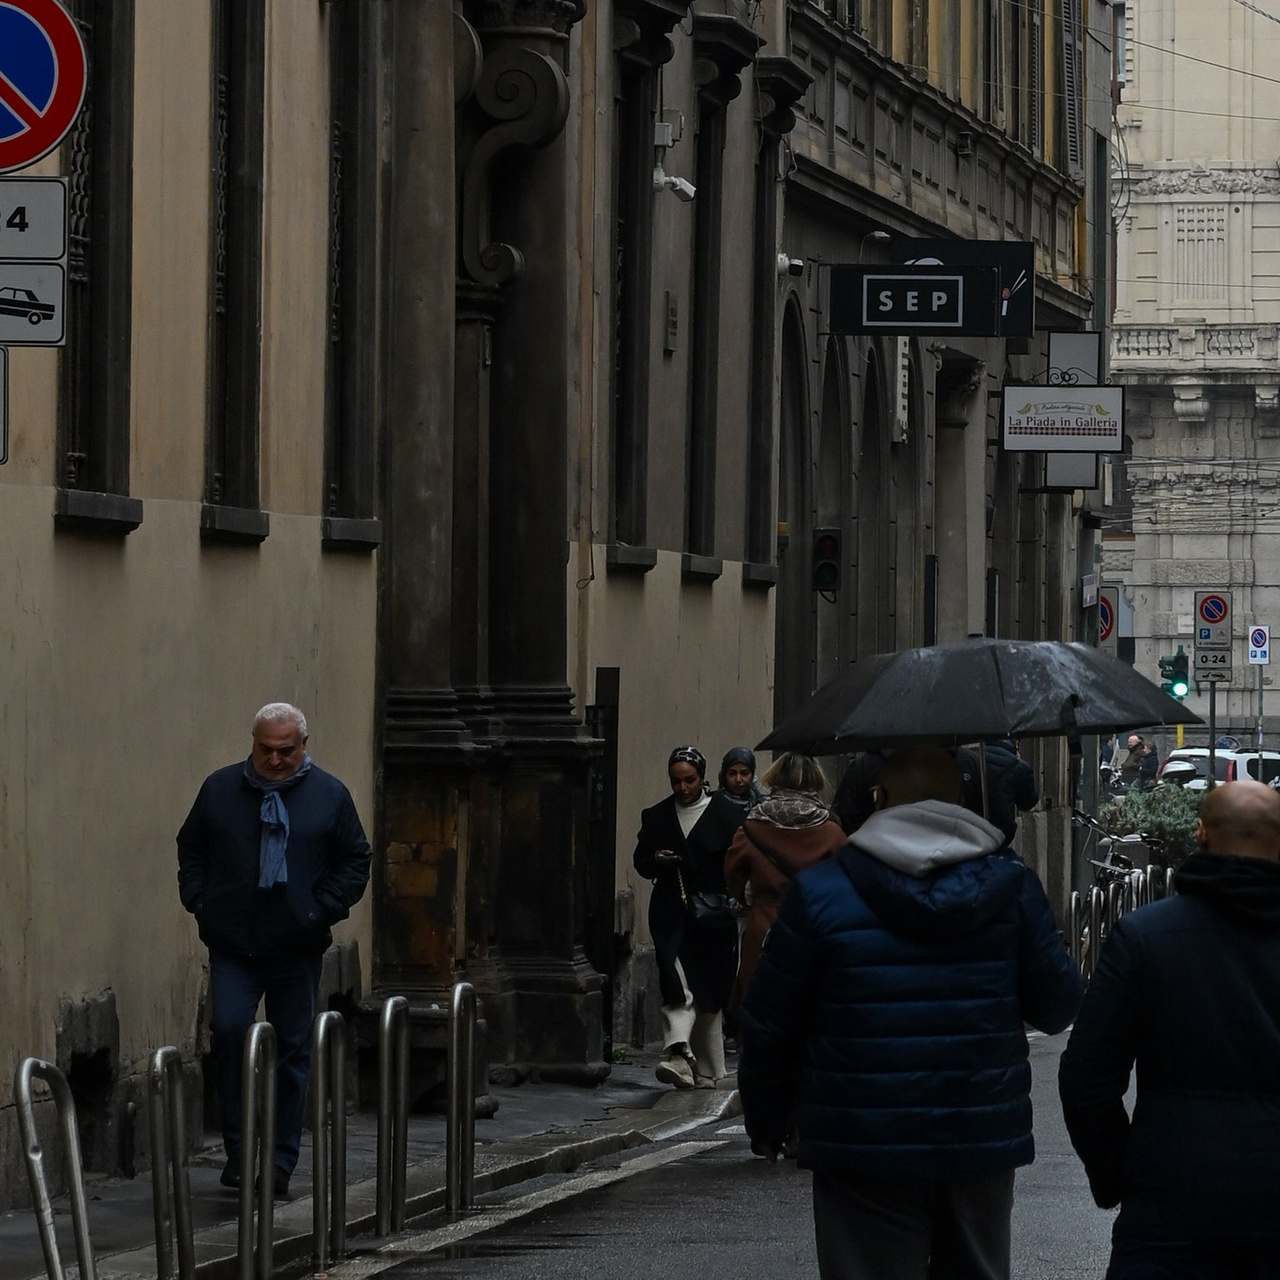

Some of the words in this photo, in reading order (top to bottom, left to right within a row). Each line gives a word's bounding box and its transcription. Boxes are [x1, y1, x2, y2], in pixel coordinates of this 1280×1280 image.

[0, 206, 29, 232] 4
[878, 290, 948, 312] SEP
[1009, 416, 1021, 426] La
[1026, 416, 1055, 427] Piada
[1061, 416, 1071, 427] in
[1075, 417, 1118, 428] Galleria
[1200, 655, 1227, 664] 0-24
